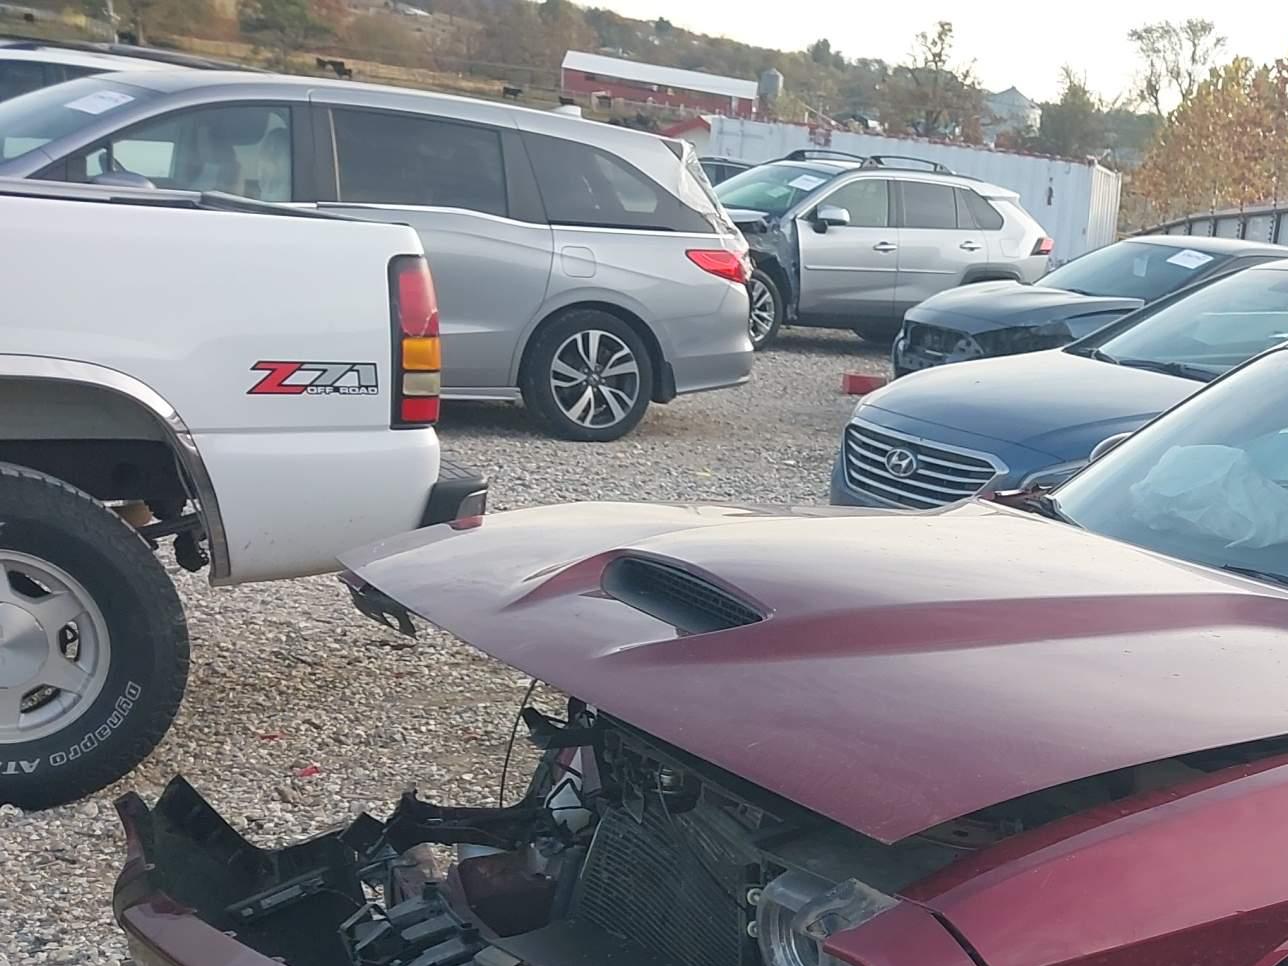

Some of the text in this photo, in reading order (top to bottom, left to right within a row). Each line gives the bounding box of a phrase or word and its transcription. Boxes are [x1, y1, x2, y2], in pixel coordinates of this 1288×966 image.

[247, 361, 379, 395] Z71
[0, 680, 142, 775] Dynapro AT
